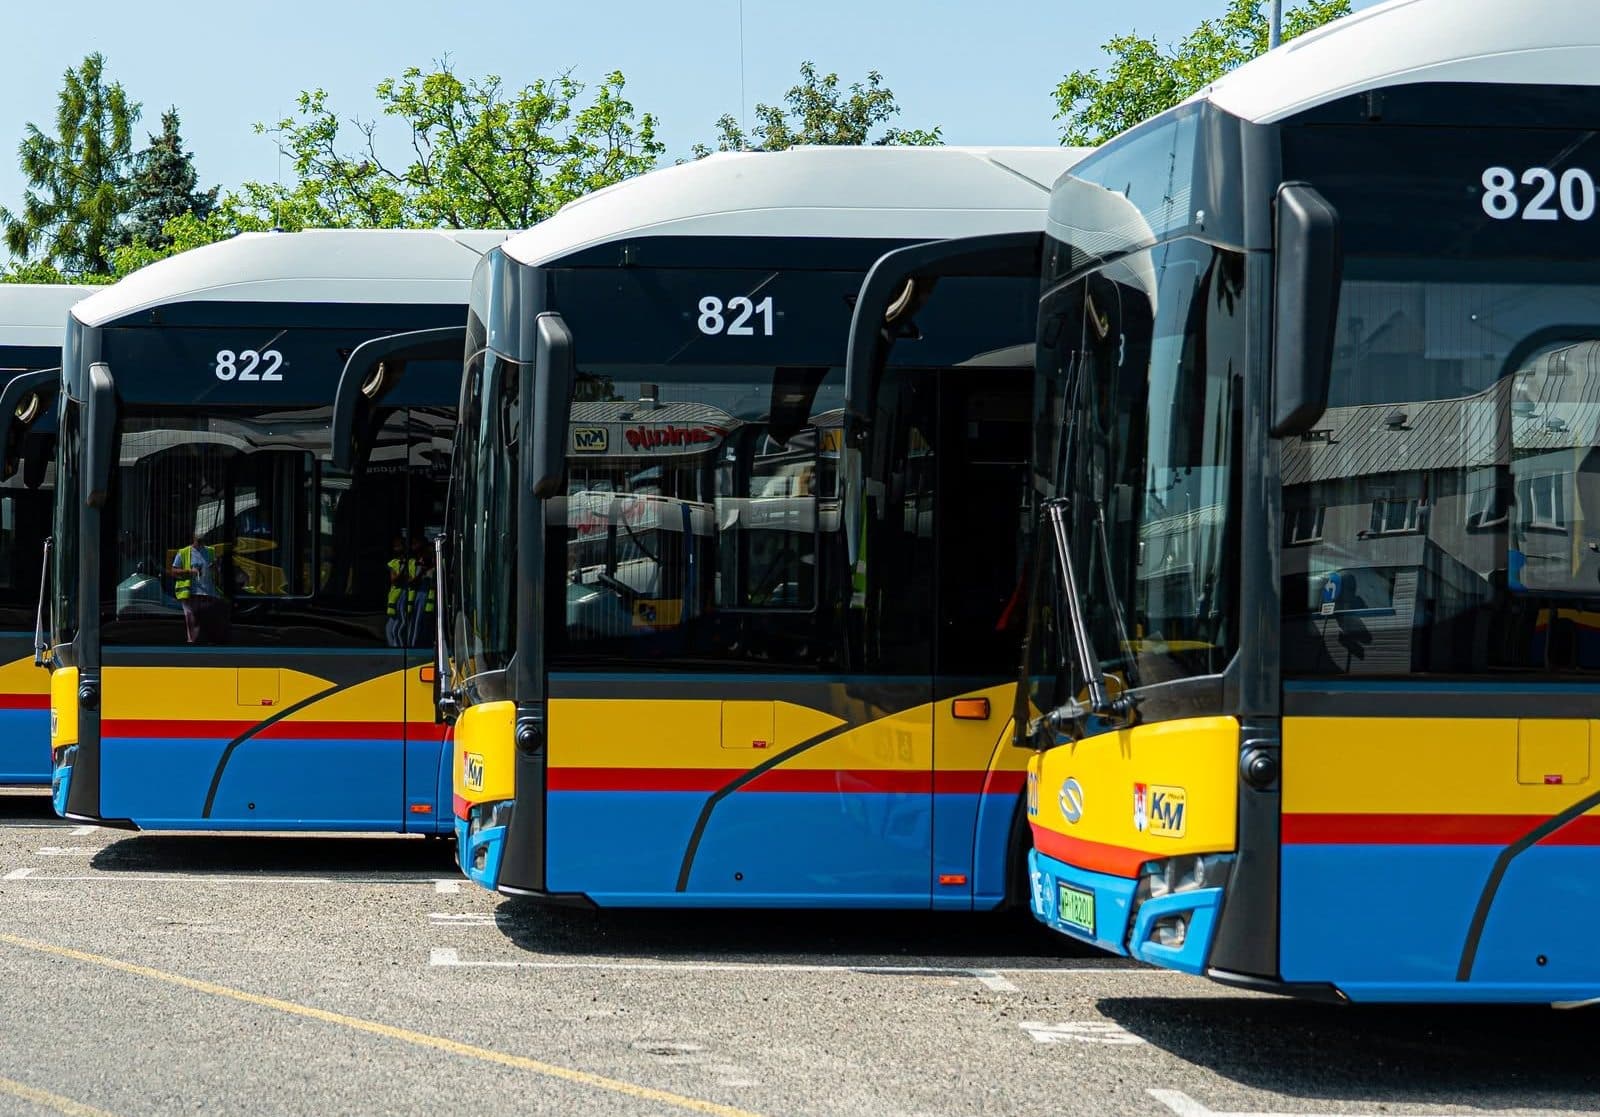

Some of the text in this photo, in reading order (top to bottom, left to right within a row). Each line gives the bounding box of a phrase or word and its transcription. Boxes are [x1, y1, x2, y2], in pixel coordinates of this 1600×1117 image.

[1481, 166, 1595, 221] 820
[697, 295, 773, 336] 821
[215, 349, 283, 381] 822
[1151, 791, 1184, 831] KM
